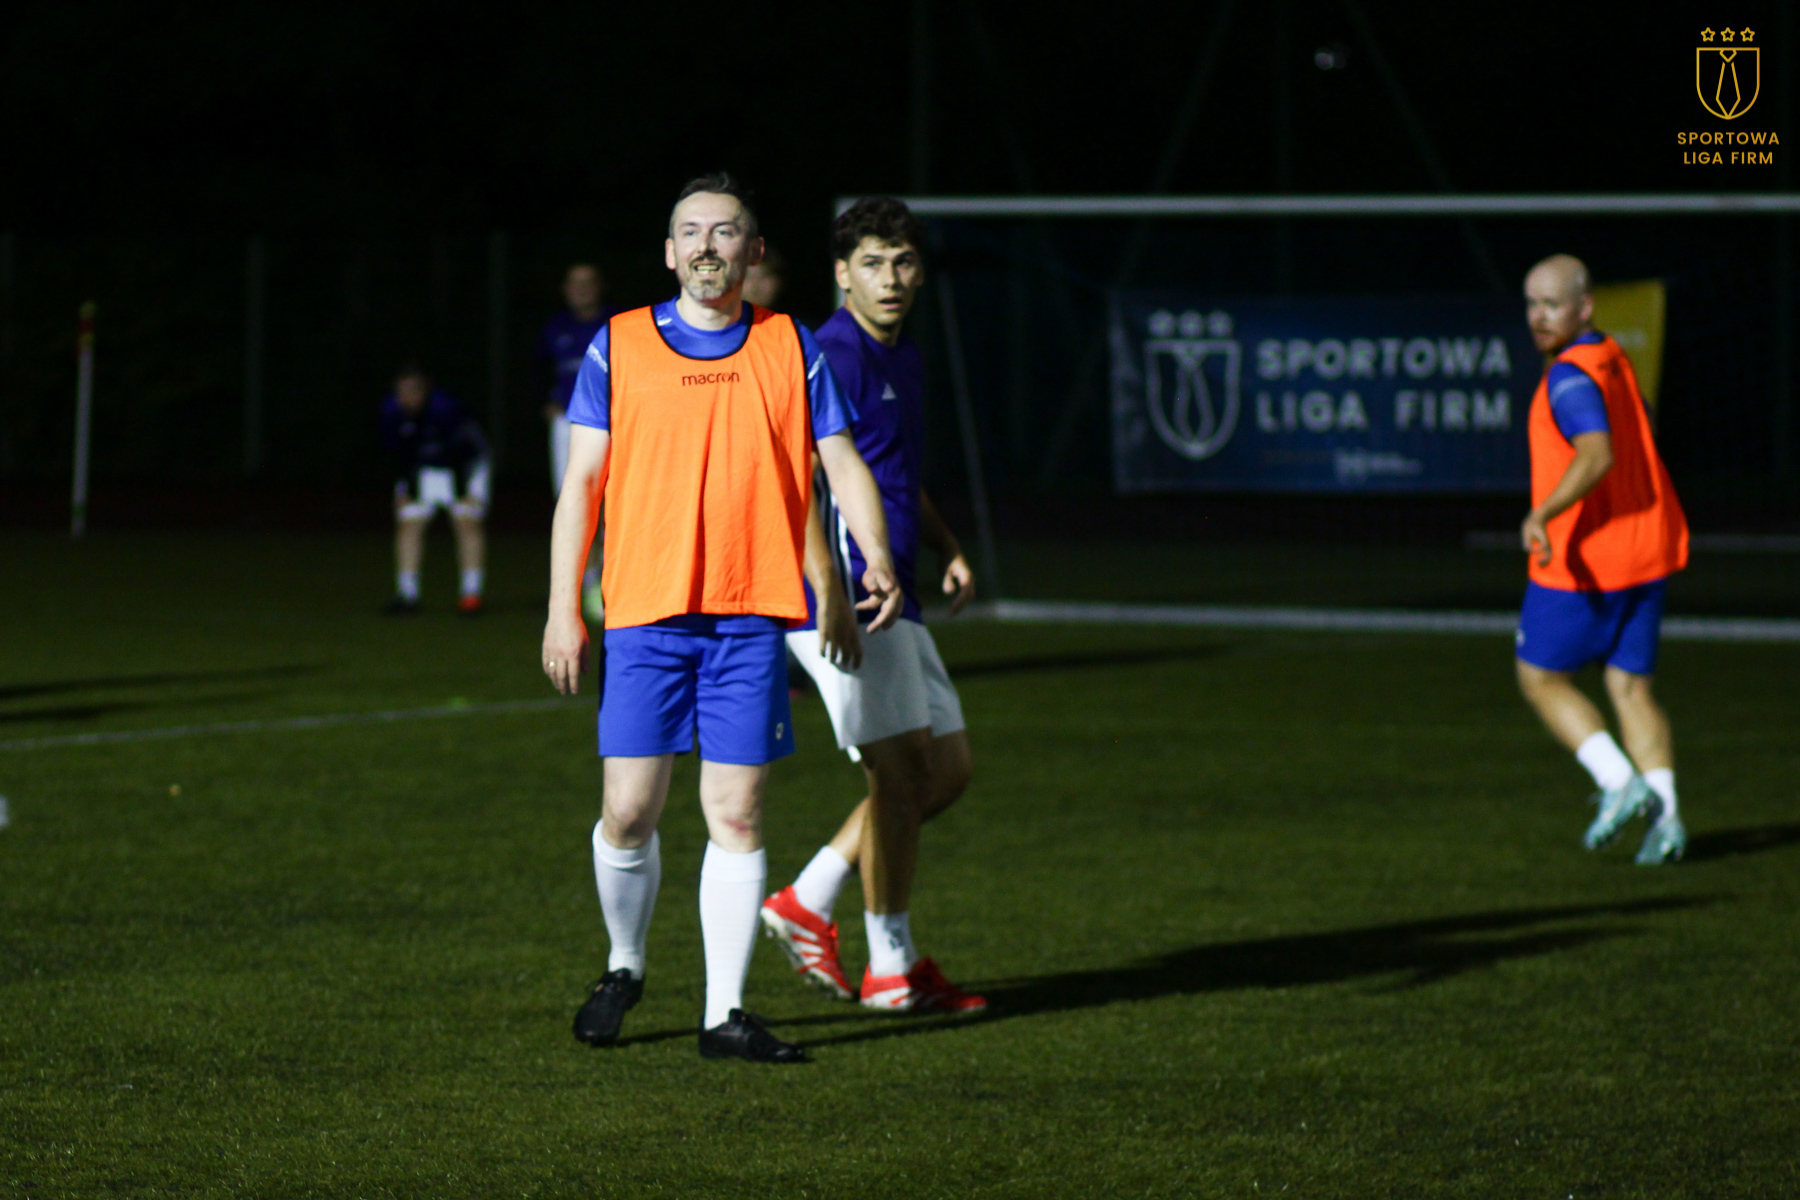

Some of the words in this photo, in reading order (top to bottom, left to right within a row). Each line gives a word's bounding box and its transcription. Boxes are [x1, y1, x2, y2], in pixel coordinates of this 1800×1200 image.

[682, 371, 740, 386] macron
[1256, 337, 1512, 380] SPORTOWA
[1257, 390, 1368, 431] LIGA
[1395, 390, 1511, 431] FIRM
